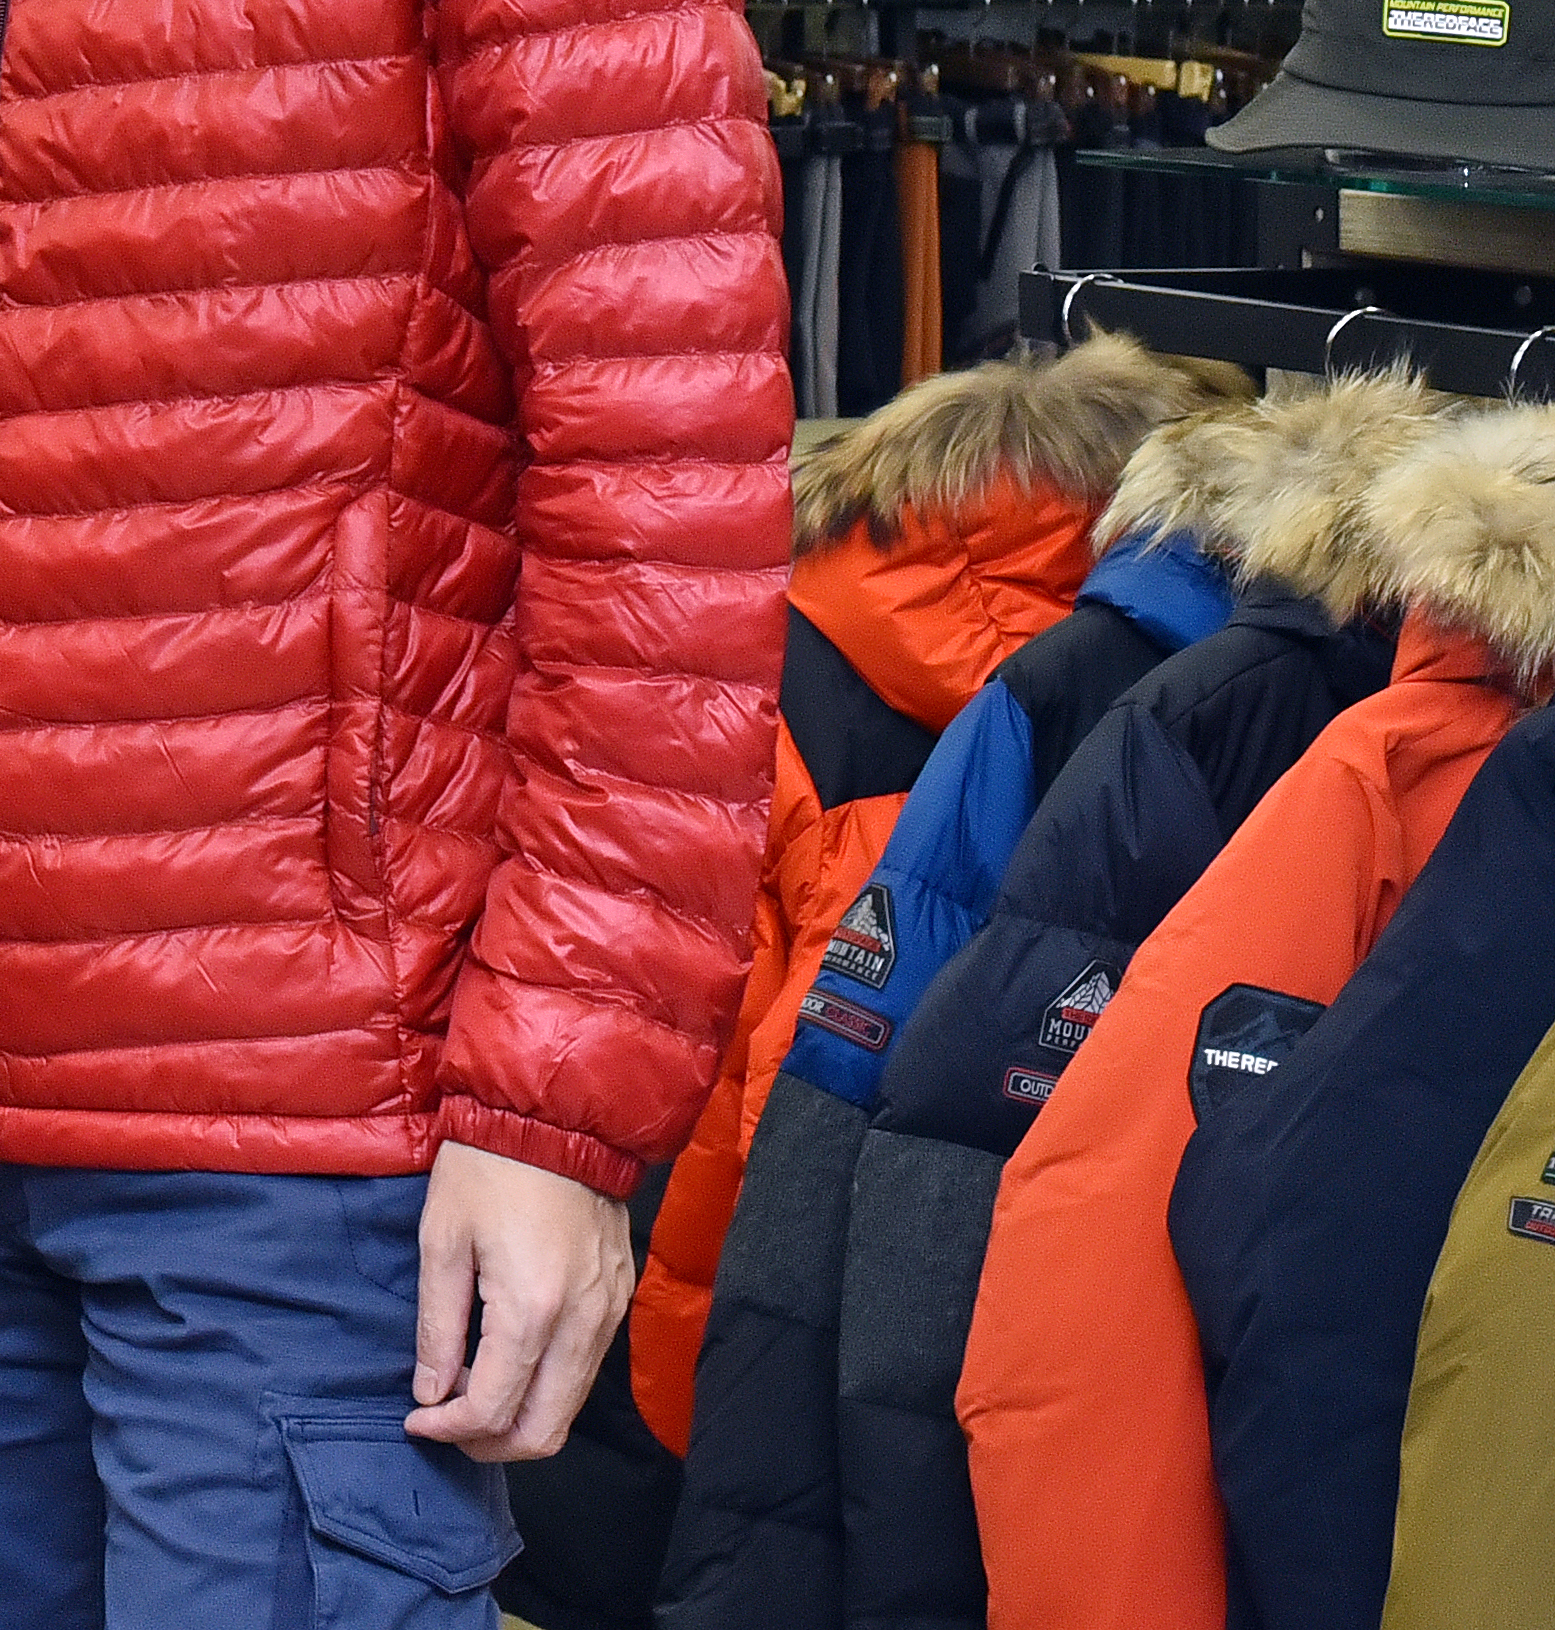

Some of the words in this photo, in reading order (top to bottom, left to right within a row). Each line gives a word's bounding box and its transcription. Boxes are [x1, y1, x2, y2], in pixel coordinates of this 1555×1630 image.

[1389, 0, 1436, 12] MOUNTAIN
[1436, 2, 1505, 19] PERFORMANCE
[1048, 1018, 1092, 1040] MOU
